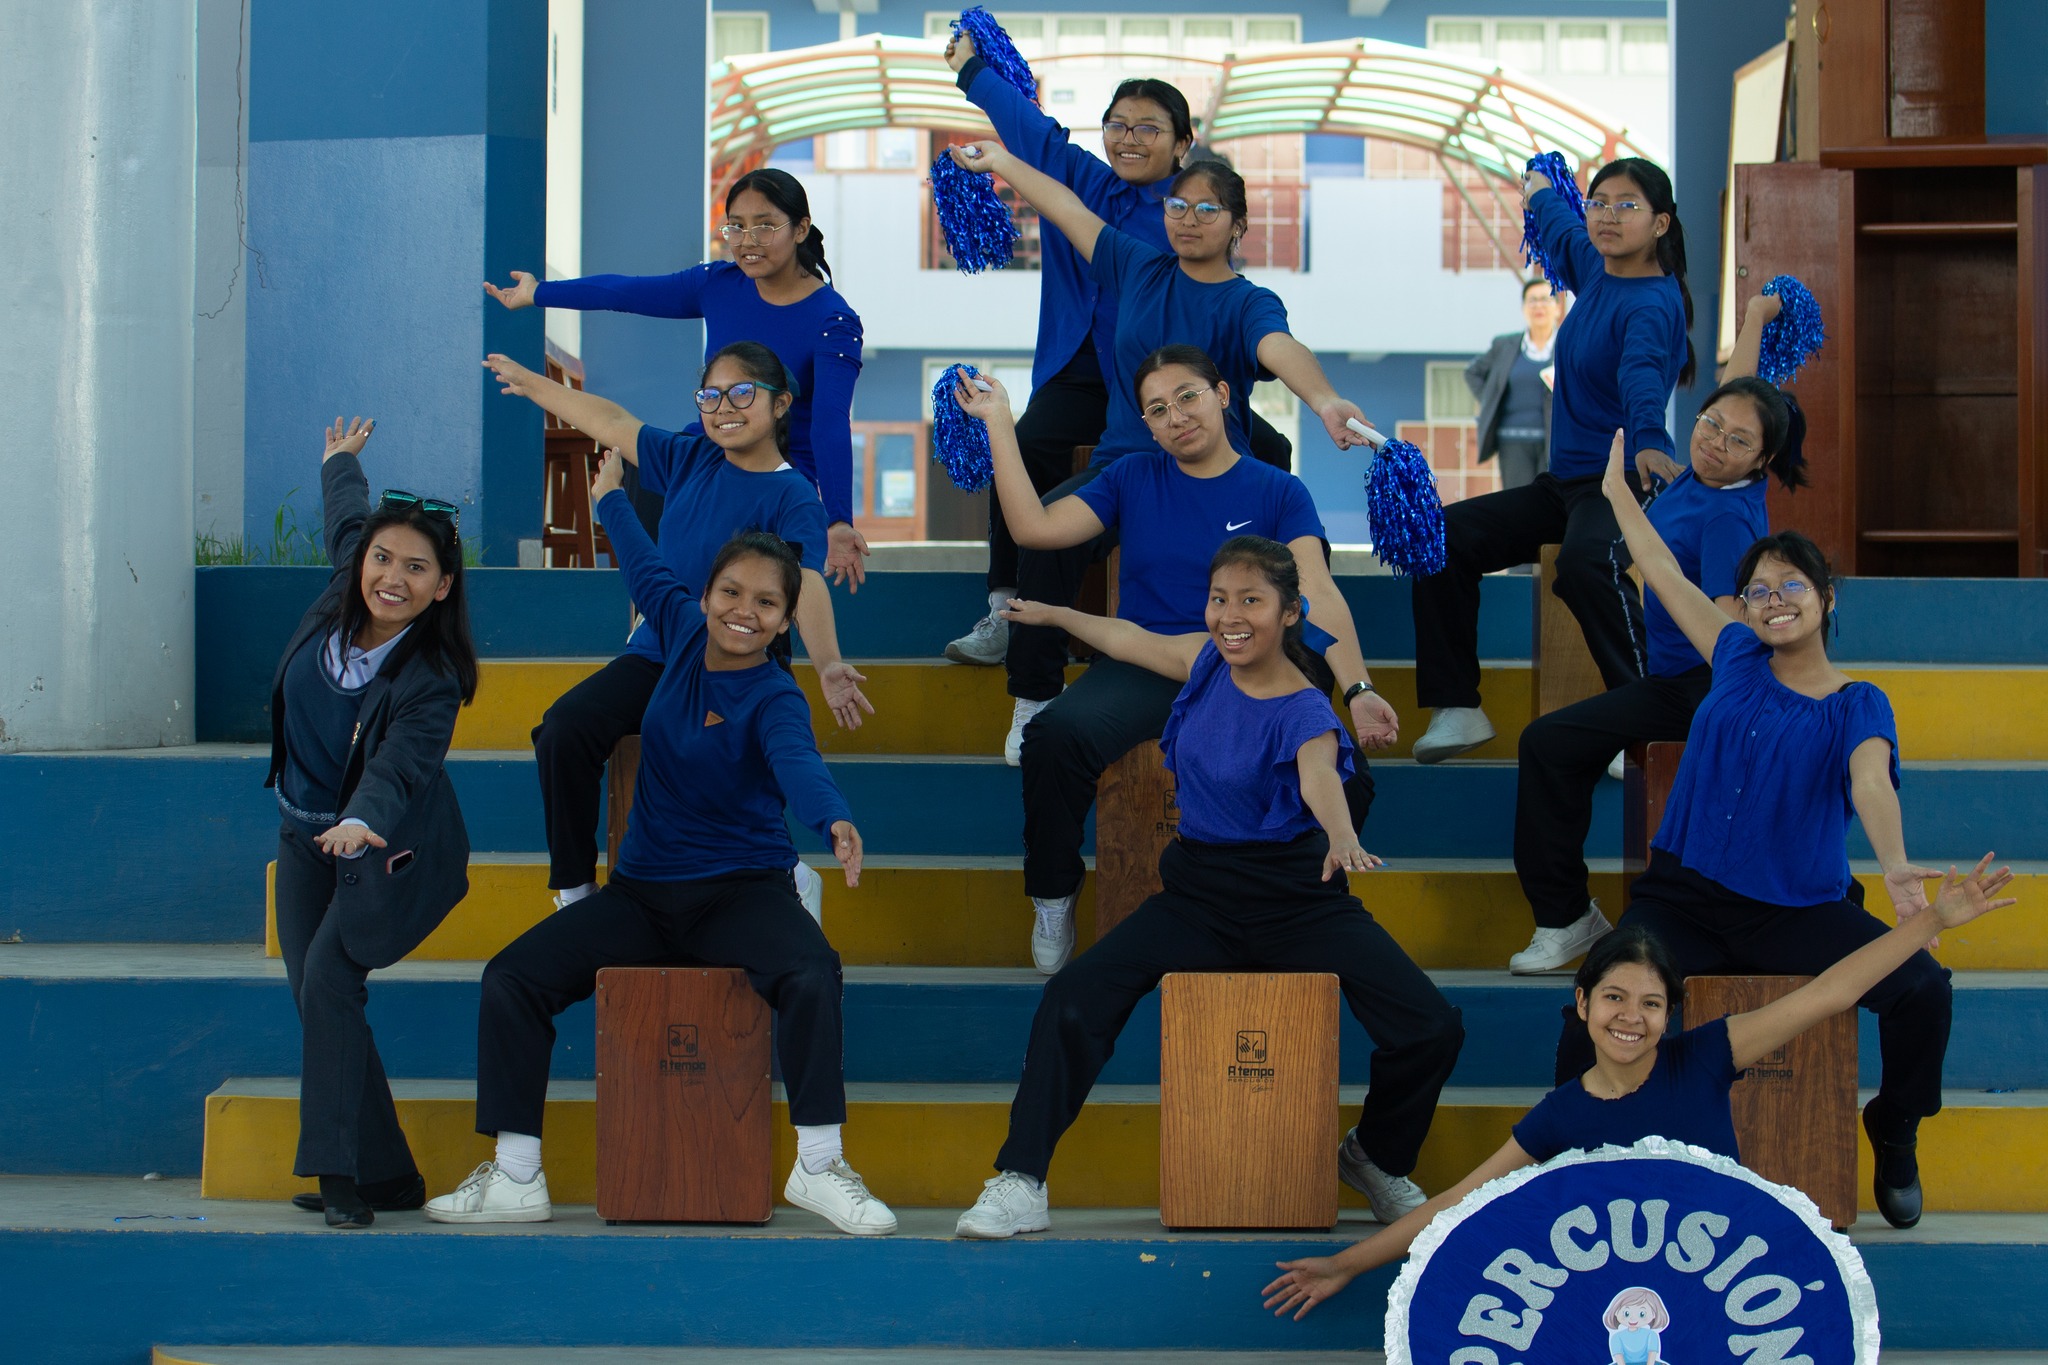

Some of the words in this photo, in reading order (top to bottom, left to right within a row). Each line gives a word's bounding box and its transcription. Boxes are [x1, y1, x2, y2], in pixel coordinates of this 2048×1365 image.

[660, 1060, 668, 1071] A
[670, 1060, 706, 1073] tempo
[1228, 1066, 1236, 1076] A
[1238, 1066, 1275, 1079] tempo
[1747, 1068, 1755, 1078] A
[1757, 1068, 1793, 1080] tempo
